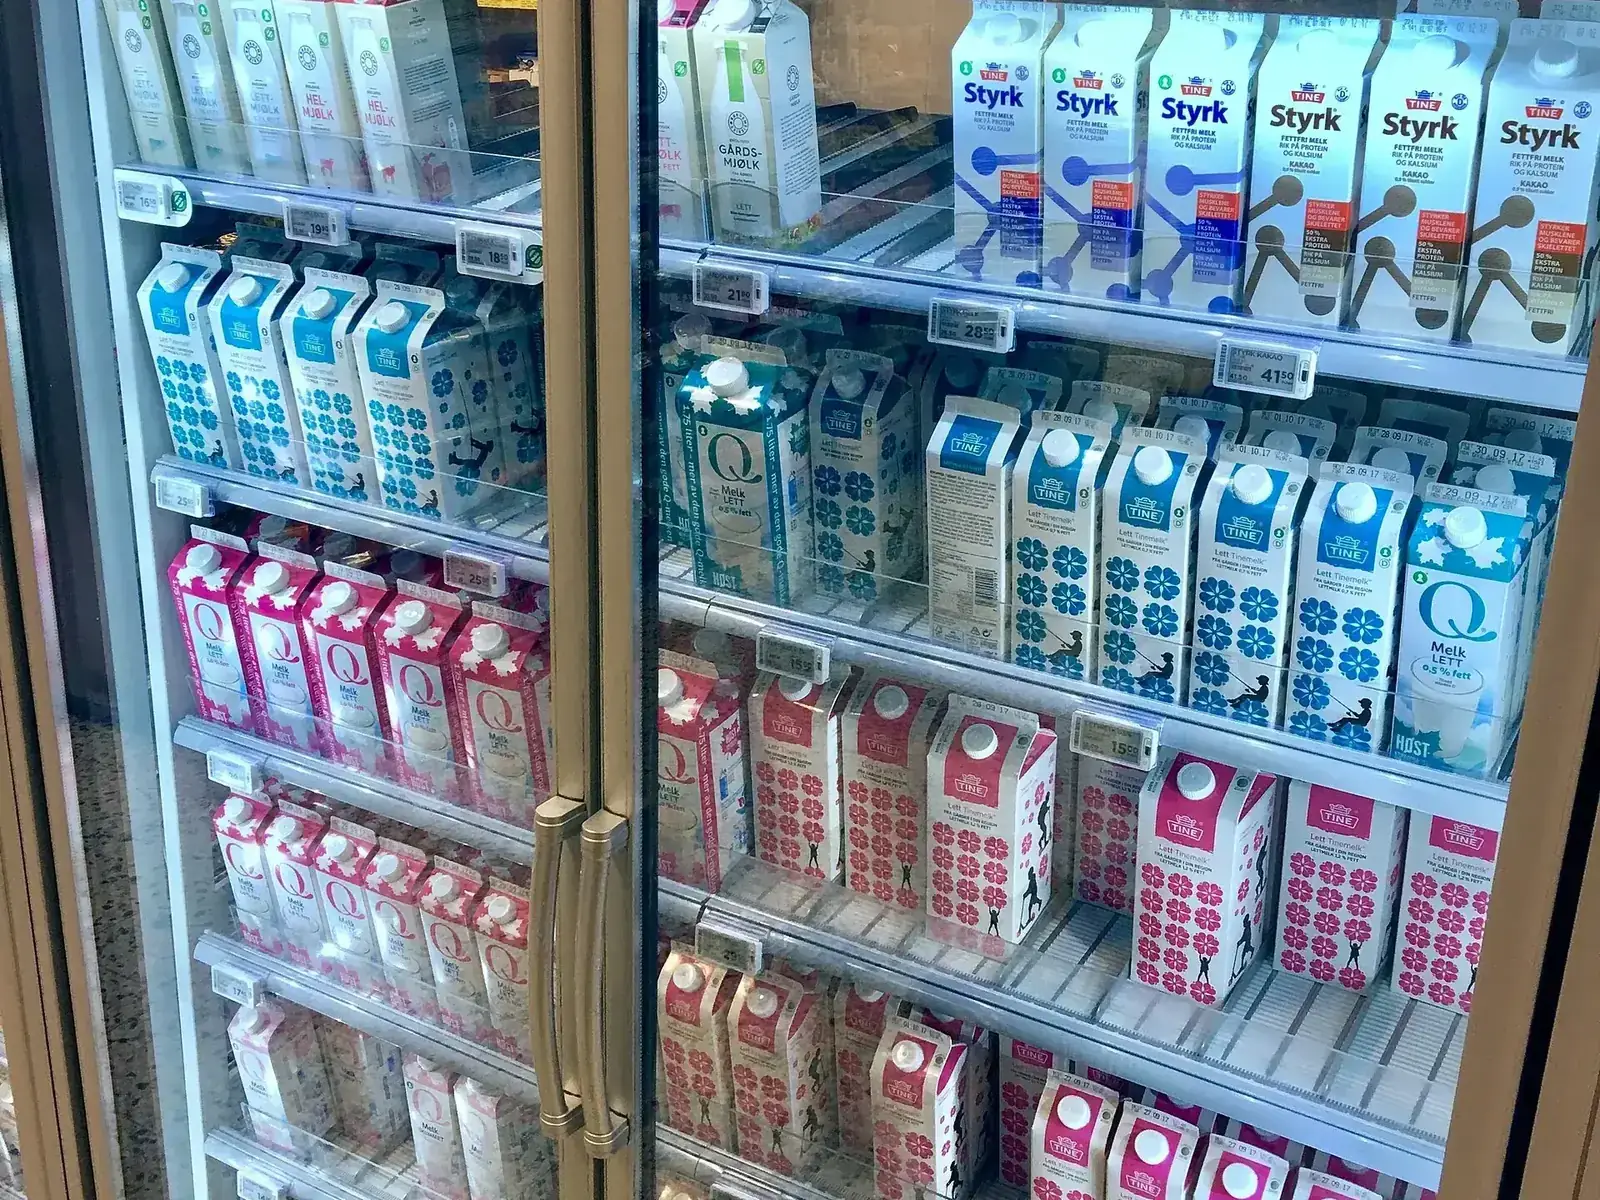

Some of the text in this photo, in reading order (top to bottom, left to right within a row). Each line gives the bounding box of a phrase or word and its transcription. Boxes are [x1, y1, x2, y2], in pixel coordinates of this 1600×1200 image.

[983, 71, 1005, 80] TINE
[1075, 79, 1099, 88] TINE
[964, 82, 1024, 110] Styrk
[1183, 86, 1208, 95] TINE
[1294, 92, 1320, 102] TINE
[306, 93, 327, 107] HEL-
[368, 100, 388, 113] HEL-
[1056, 90, 1119, 118] Styrk
[1409, 100, 1438, 110] TINE
[302, 106, 334, 121] MJØLK
[1162, 98, 1228, 127] Styrk
[1270, 104, 1342, 134] Styrk
[1529, 108, 1558, 118] TINE
[365, 112, 396, 127] MJØLK
[1382, 112, 1459, 143] Styrk
[1500, 120, 1581, 152] Styrk
[719, 144, 762, 157] GÅRDS-
[724, 158, 760, 170] MJØLK
[1512, 152, 1564, 163] FETTFRI MELK
[378, 357, 397, 367] TINE
[830, 419, 852, 430] TINE
[956, 441, 981, 453] TINE
[708, 433, 763, 484] Q
[722, 485, 745, 498] Melk
[1037, 488, 1065, 501] TINE
[724, 496, 744, 507] LETT
[1130, 508, 1158, 520] TINE
[1119, 529, 1133, 537] Lett
[1227, 527, 1257, 540] TINE
[1215, 549, 1229, 558] Lett
[1330, 547, 1362, 560] TINE
[1317, 569, 1332, 578] Lett
[1419, 581, 1497, 642] Q
[194, 603, 229, 642] Q
[260, 623, 299, 663] Q
[1431, 641, 1467, 659] Melk
[327, 644, 369, 686] Q
[1433, 654, 1463, 668] LETT
[1440, 667, 1451, 677] %
[1453, 669, 1472, 680] fett
[399, 664, 442, 707] Q
[476, 690, 522, 733] Q
[777, 722, 798, 735] TINE
[871, 741, 894, 753] TINE
[1396, 734, 1431, 759] HØST
[960, 782, 983, 794] TINE
[1325, 813, 1352, 825] TINE
[1172, 824, 1198, 837] TINE
[1449, 833, 1477, 847] TINE
[326, 881, 365, 920] Q
[430, 922, 472, 963] Q
[485, 944, 528, 985] Q
[1020, 1049, 1044, 1060] TINE
[891, 1088, 913, 1099] TINE
[1055, 1144, 1079, 1157] TINE
[1130, 1177, 1159, 1195] TINE
